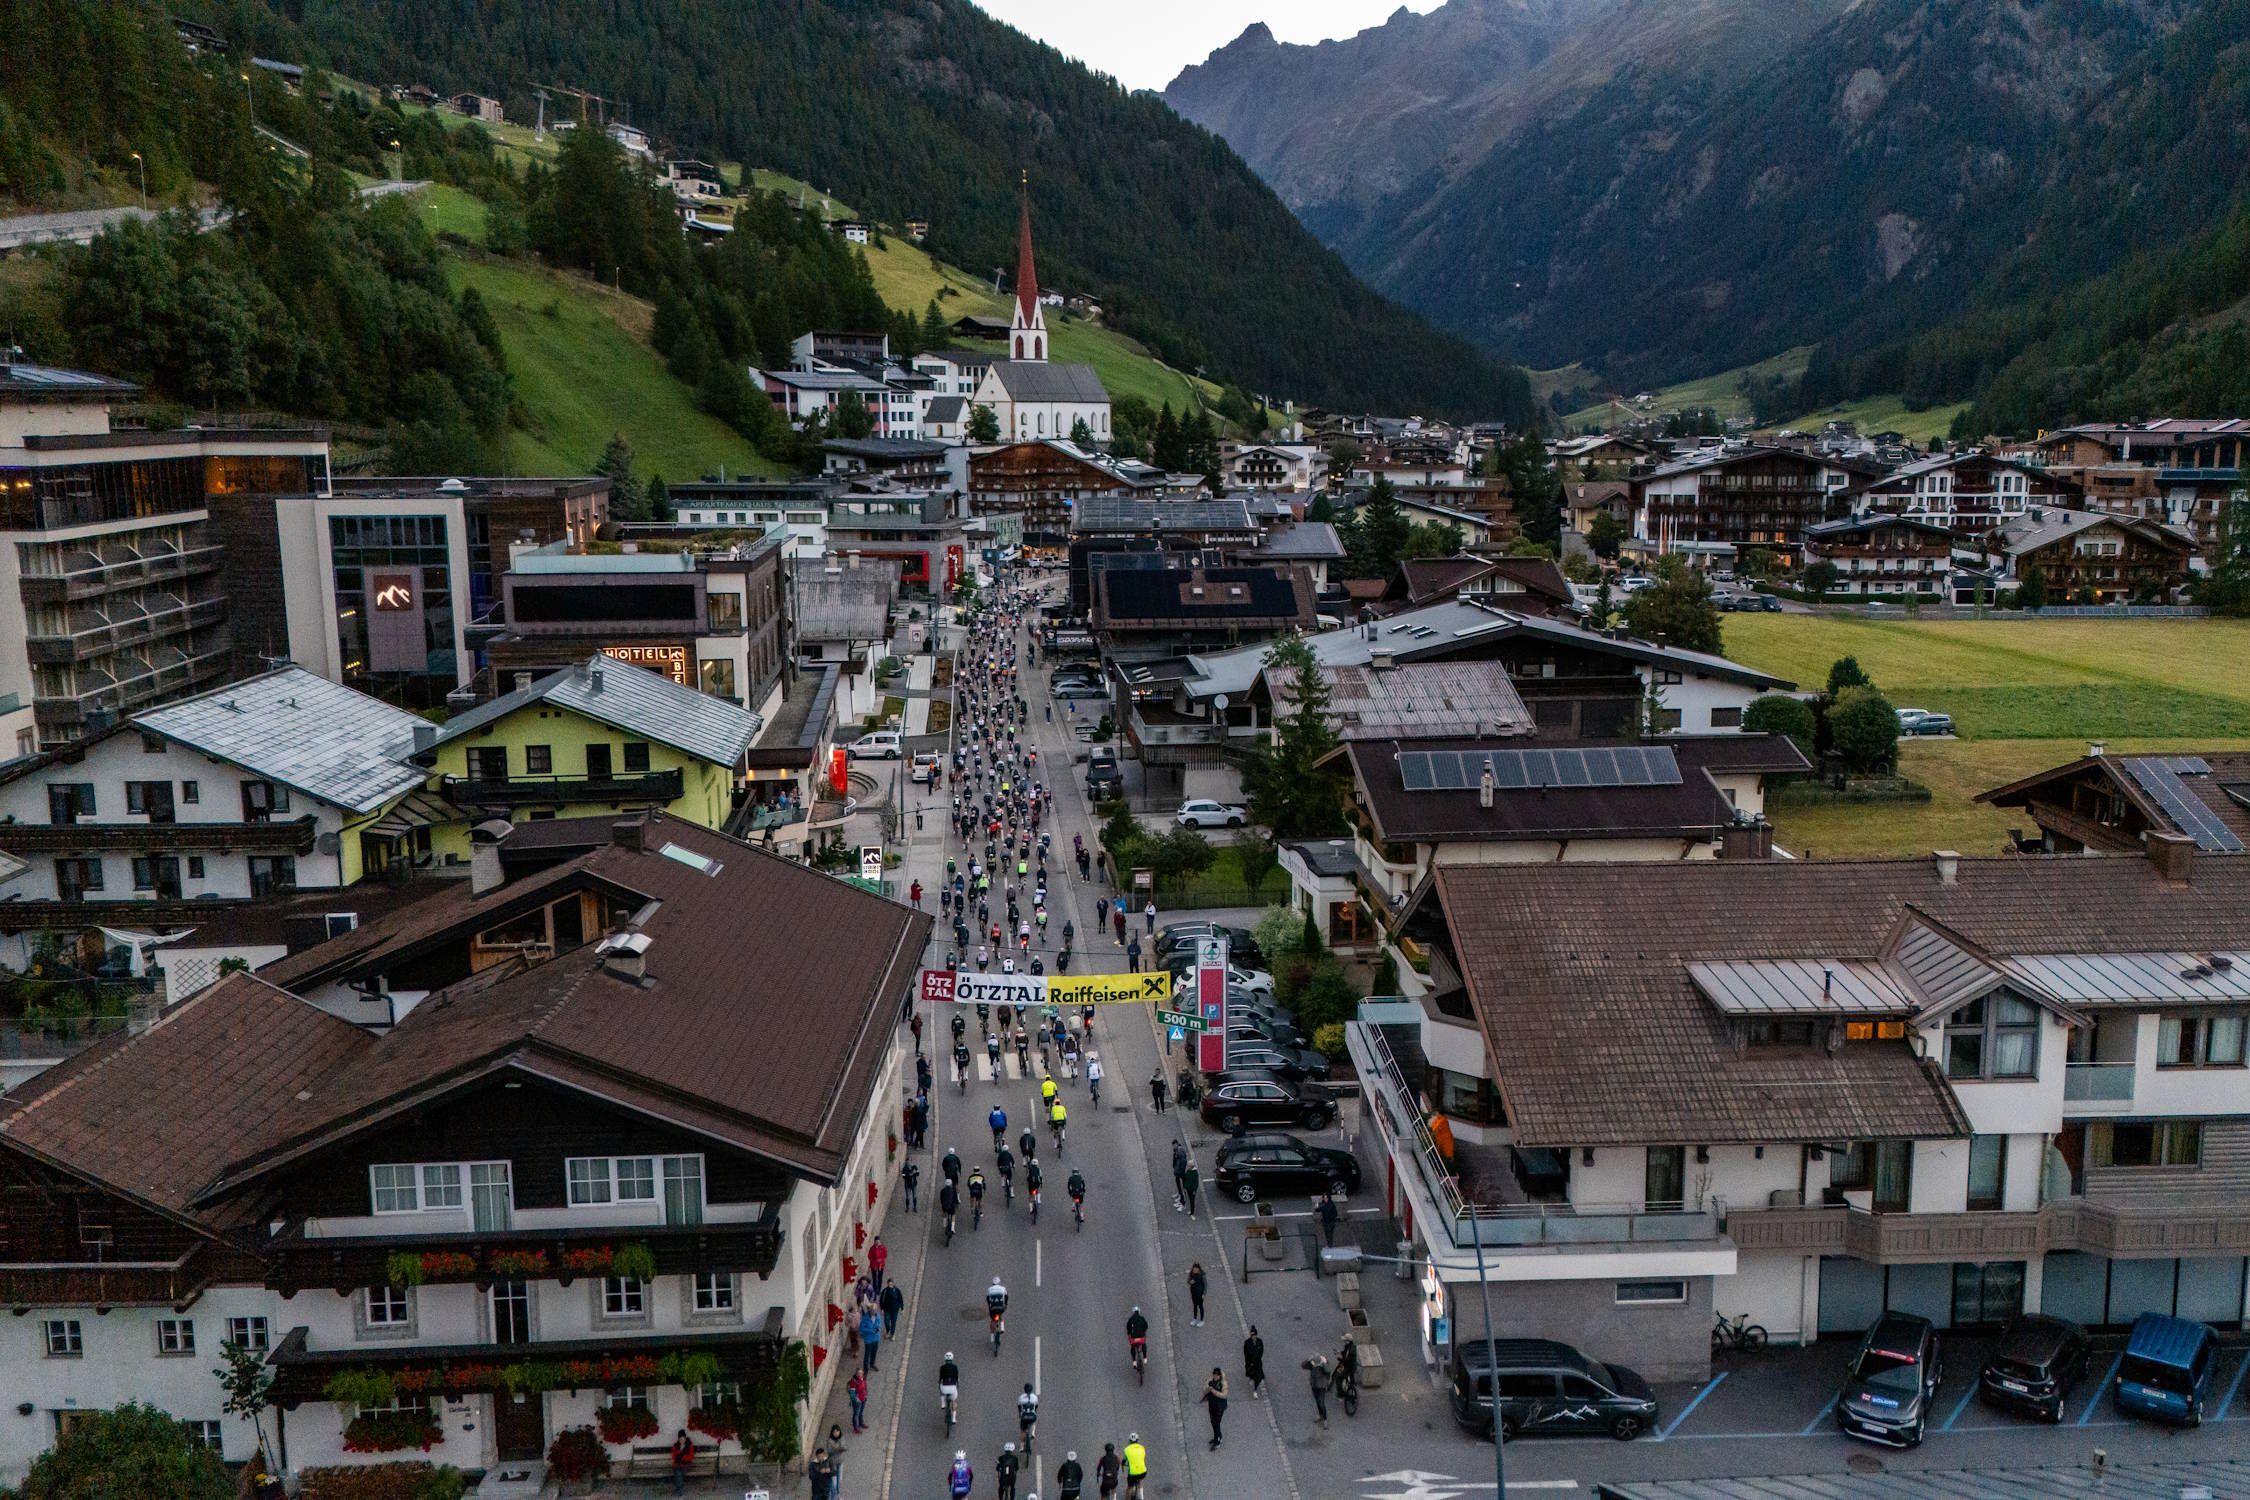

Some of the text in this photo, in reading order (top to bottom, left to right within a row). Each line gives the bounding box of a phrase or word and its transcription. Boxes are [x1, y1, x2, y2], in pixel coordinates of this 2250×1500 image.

[605, 650, 667, 659] HOTEL
[926, 973, 952, 987] ÖTZ
[926, 987, 950, 998] TAL
[957, 977, 1045, 1002] ÖTZTAL
[1050, 986, 1139, 1003] Raiffeisen
[1163, 1013, 1202, 1029] 500 m
